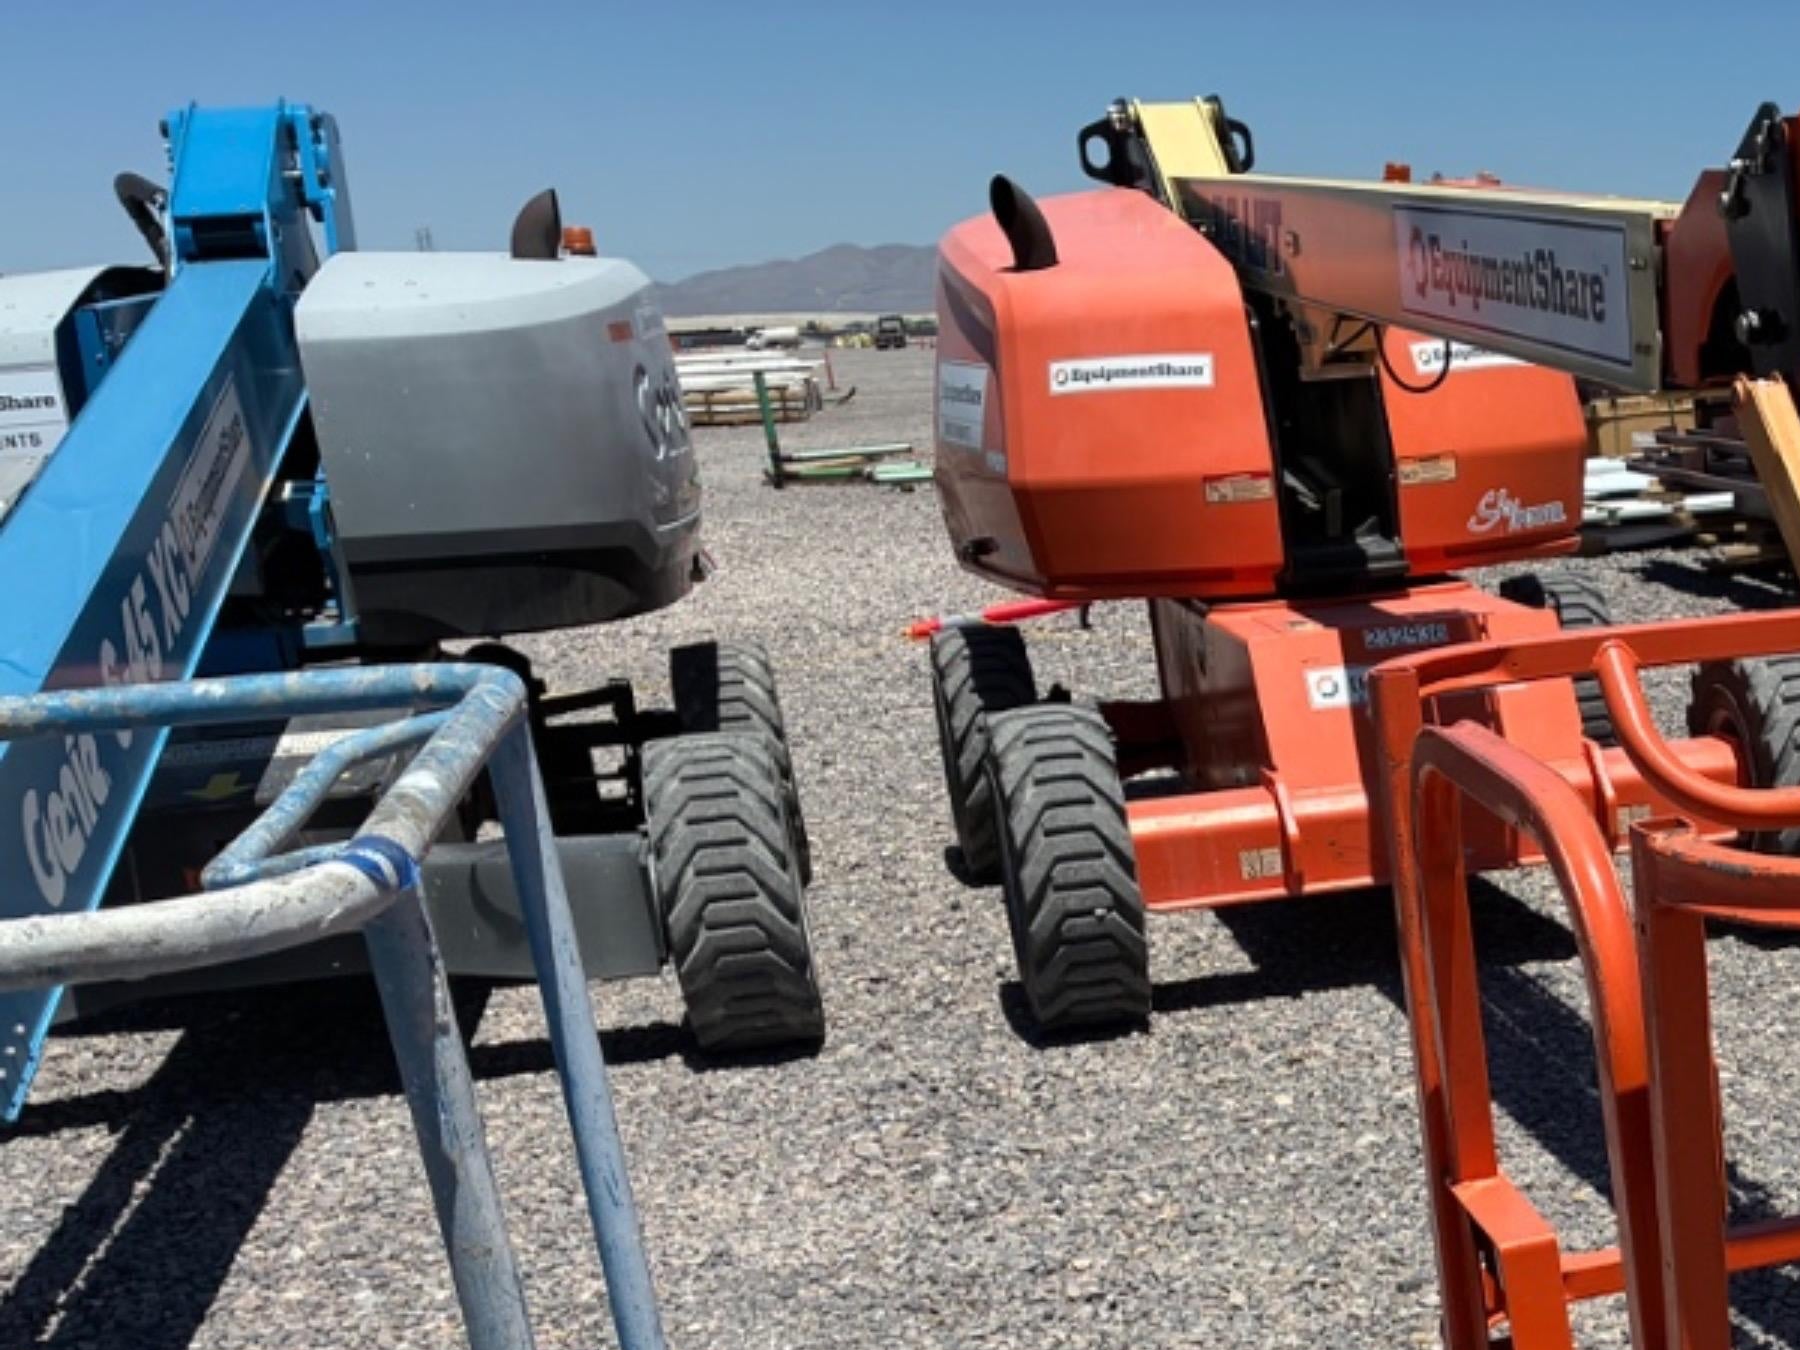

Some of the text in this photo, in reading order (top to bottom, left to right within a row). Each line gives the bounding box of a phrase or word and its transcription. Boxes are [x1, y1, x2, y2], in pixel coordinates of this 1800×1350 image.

[1427, 232, 1606, 322] EquipmentShare
[1071, 364, 1204, 383] EquipmentShare
[147, 521, 190, 651] XC
